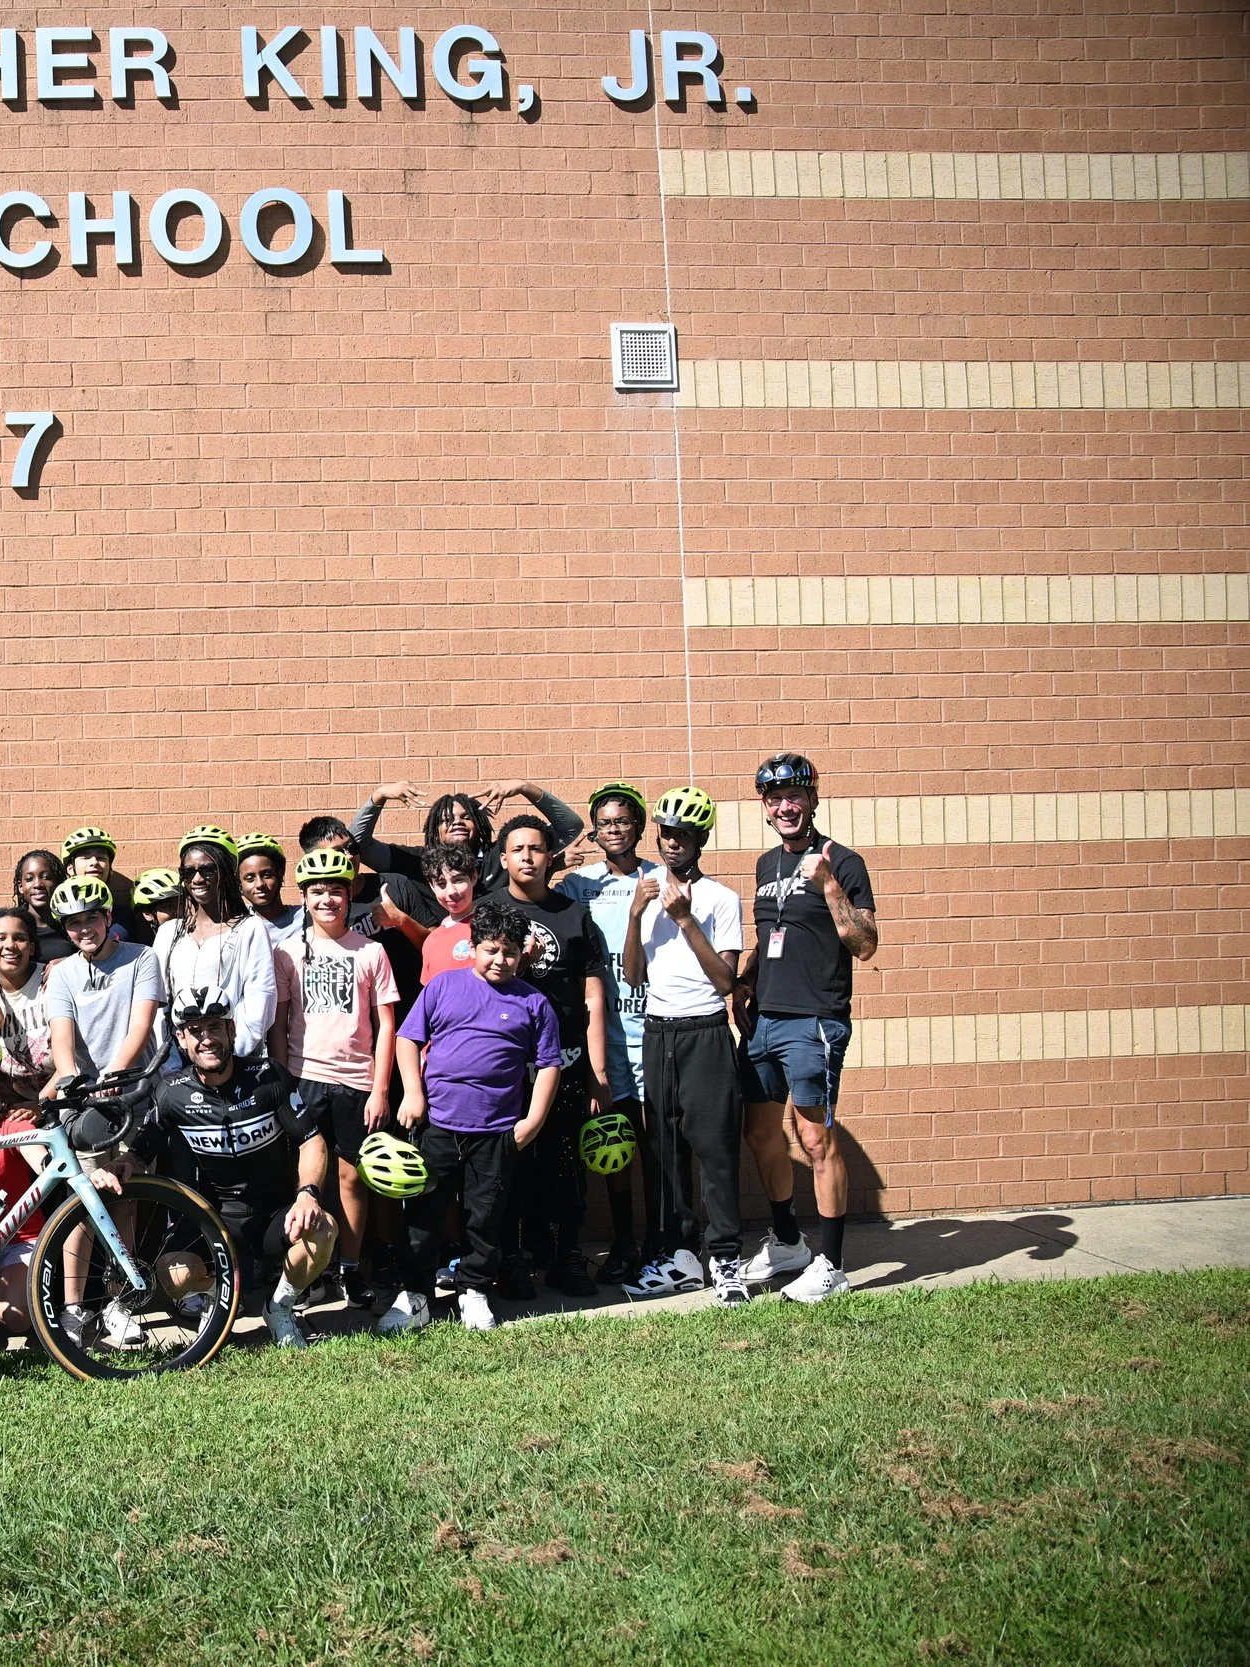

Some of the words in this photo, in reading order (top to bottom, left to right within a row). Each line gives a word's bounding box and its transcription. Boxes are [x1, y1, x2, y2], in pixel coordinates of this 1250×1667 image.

[241, 25, 534, 113] KING,
[601, 29, 752, 102] JR.
[83, 972, 115, 992] NIKE
[305, 972, 354, 983] HURLEY
[169, 1076, 191, 1087] JACK
[228, 1095, 257, 1112] OUTRIDE
[190, 1122, 274, 1149] NEWFORM
[213, 1243, 230, 1310] roval
[42, 1259, 59, 1328] roval
